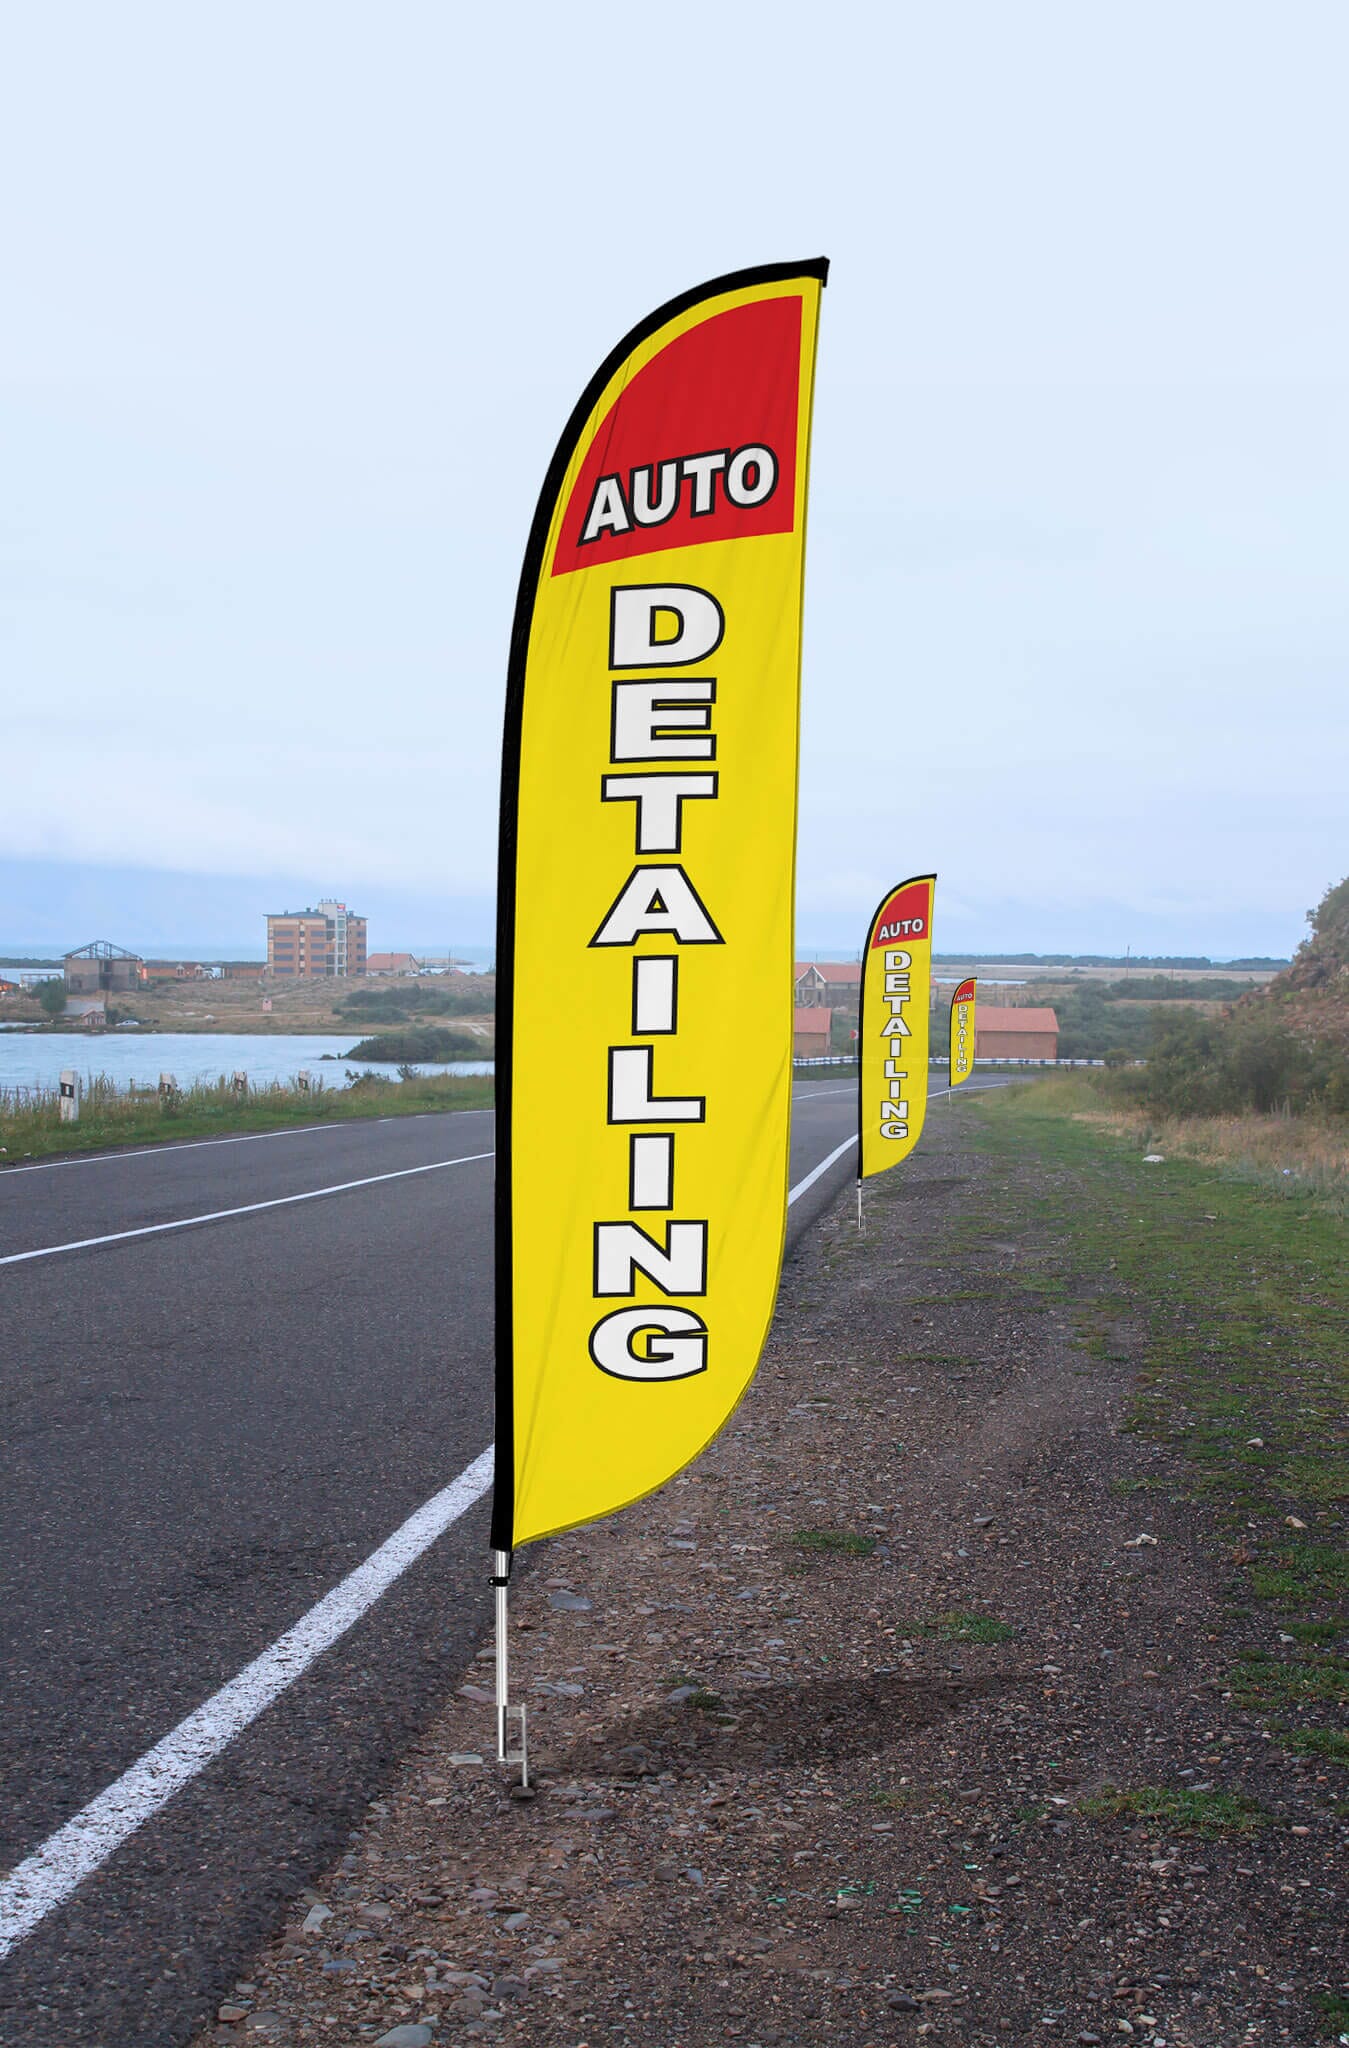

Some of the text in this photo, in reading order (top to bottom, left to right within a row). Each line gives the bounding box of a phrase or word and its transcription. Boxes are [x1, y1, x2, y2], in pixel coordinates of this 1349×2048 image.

[577, 442, 778, 546] AUTO
[878, 917, 924, 941] AUTO
[587, 582, 726, 1383] DETAILING
[957, 993, 973, 1001] AUTO
[880, 950, 912, 1139] DETAILING
[956, 1004, 968, 1072] DETAILING
